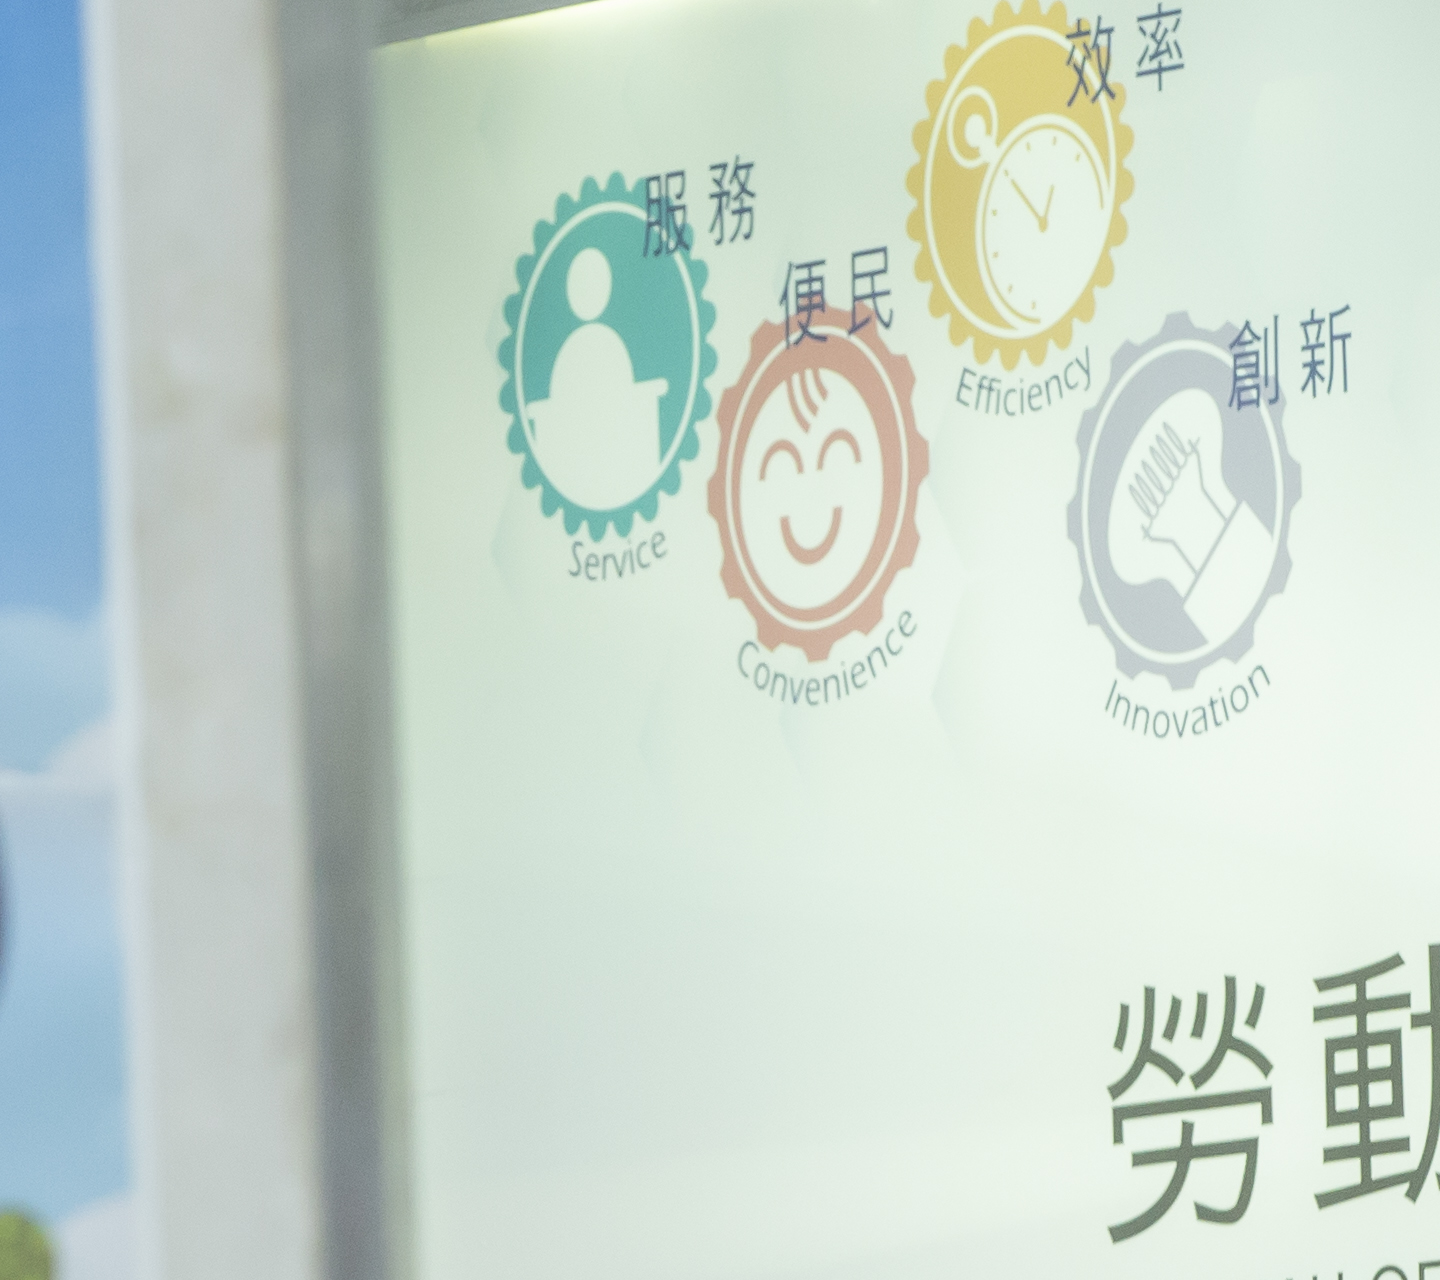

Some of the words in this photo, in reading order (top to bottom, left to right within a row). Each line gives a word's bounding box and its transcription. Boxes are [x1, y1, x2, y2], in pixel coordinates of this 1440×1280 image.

[1064, 2, 1186, 109] 效率
[640, 154, 758, 259] 服務
[778, 246, 895, 350] 便民
[954, 345, 1093, 419] Efficiency
[1224, 303, 1354, 413] 創新
[567, 527, 670, 583] Service
[736, 608, 919, 709] Convenience
[1104, 660, 1272, 741] Innovation
